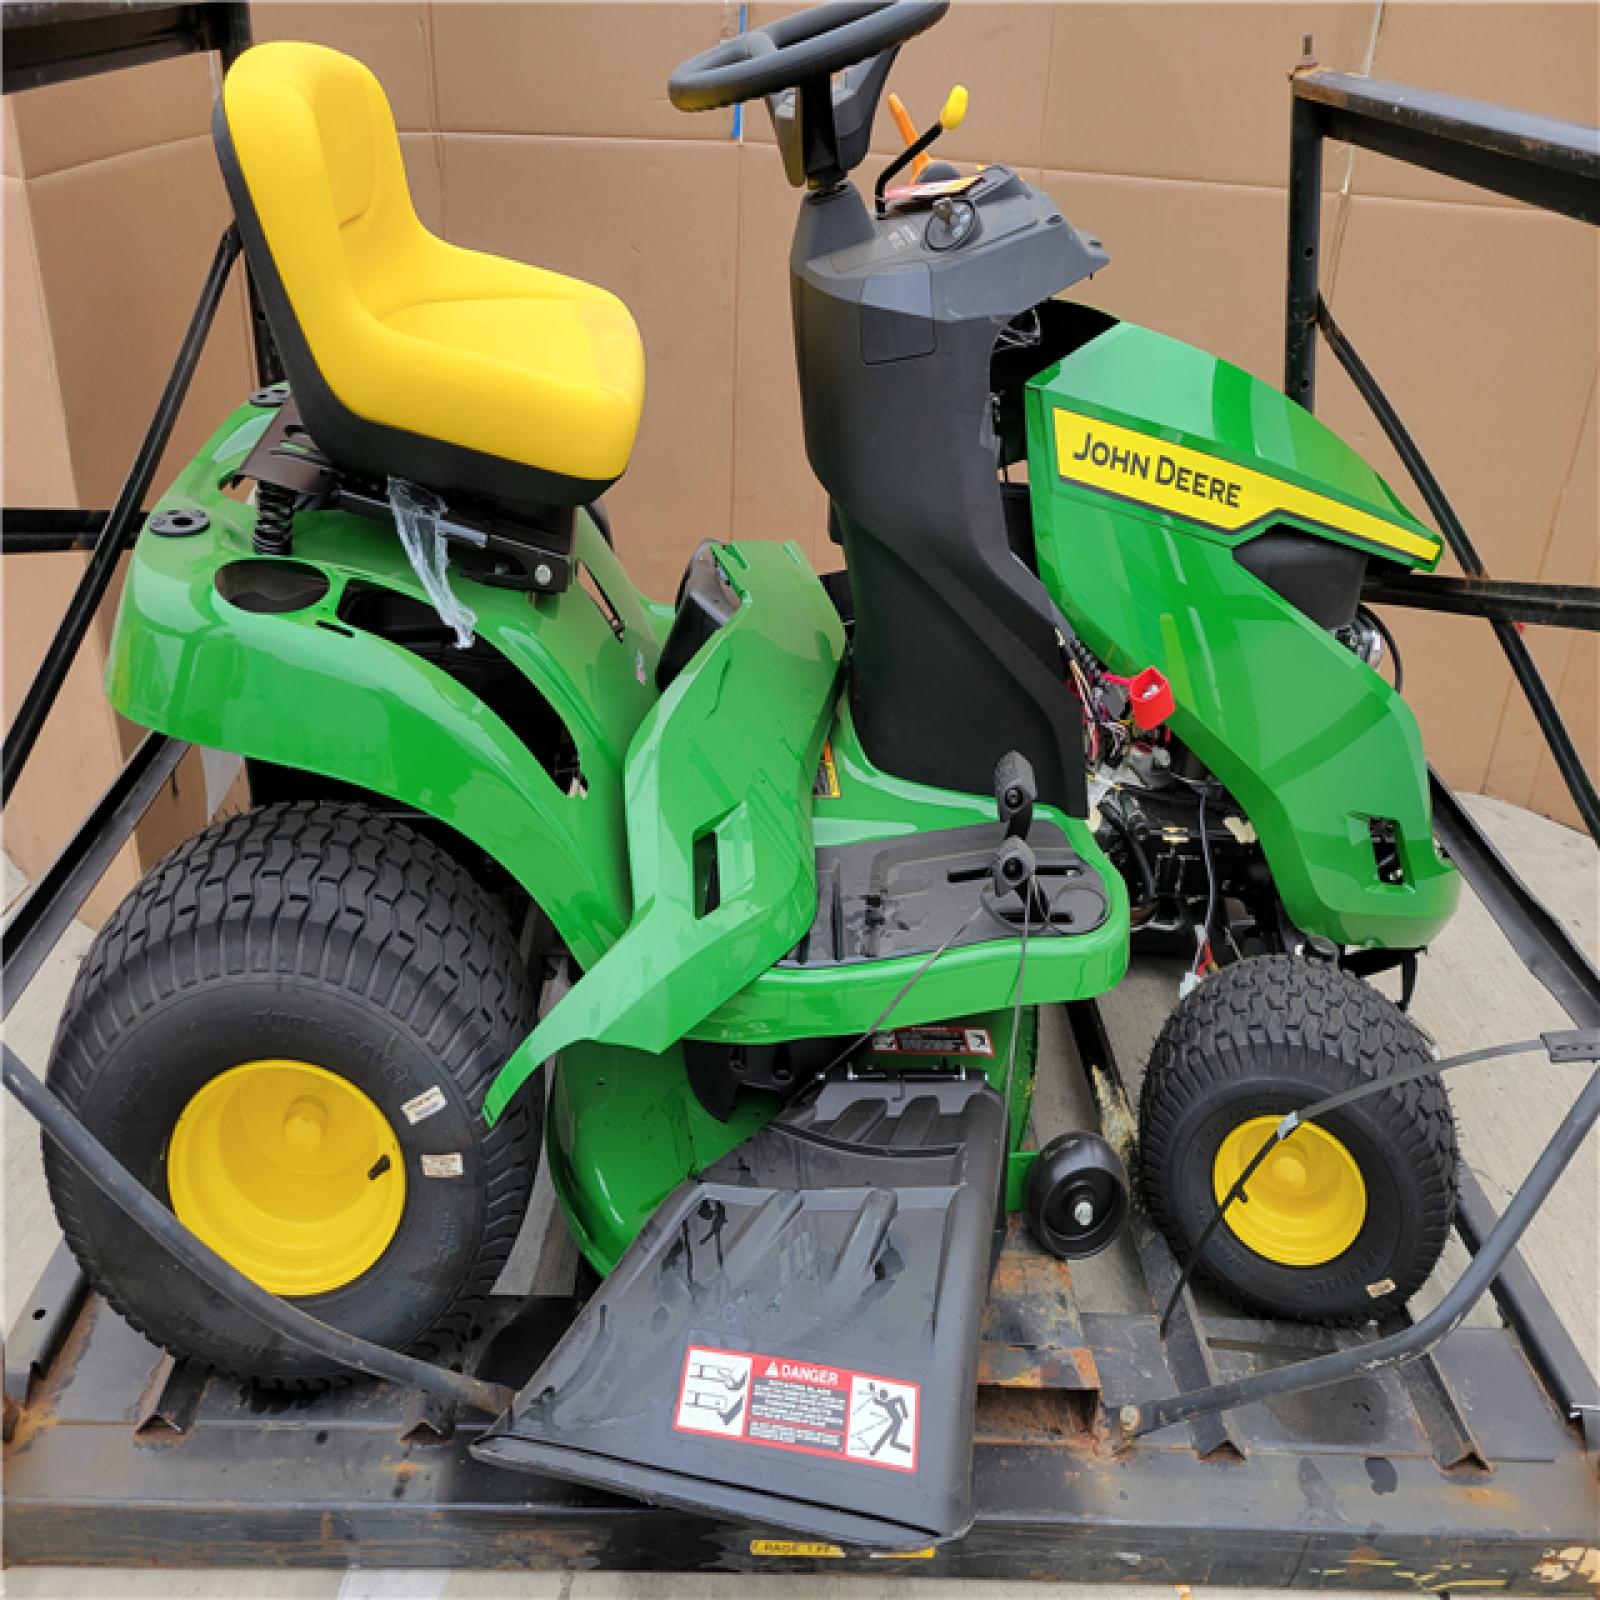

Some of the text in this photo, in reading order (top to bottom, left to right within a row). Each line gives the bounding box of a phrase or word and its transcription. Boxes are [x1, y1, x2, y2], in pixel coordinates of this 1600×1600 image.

[1072, 432, 1242, 508] JOHN DEERE
[781, 1363, 838, 1386] DANGER
